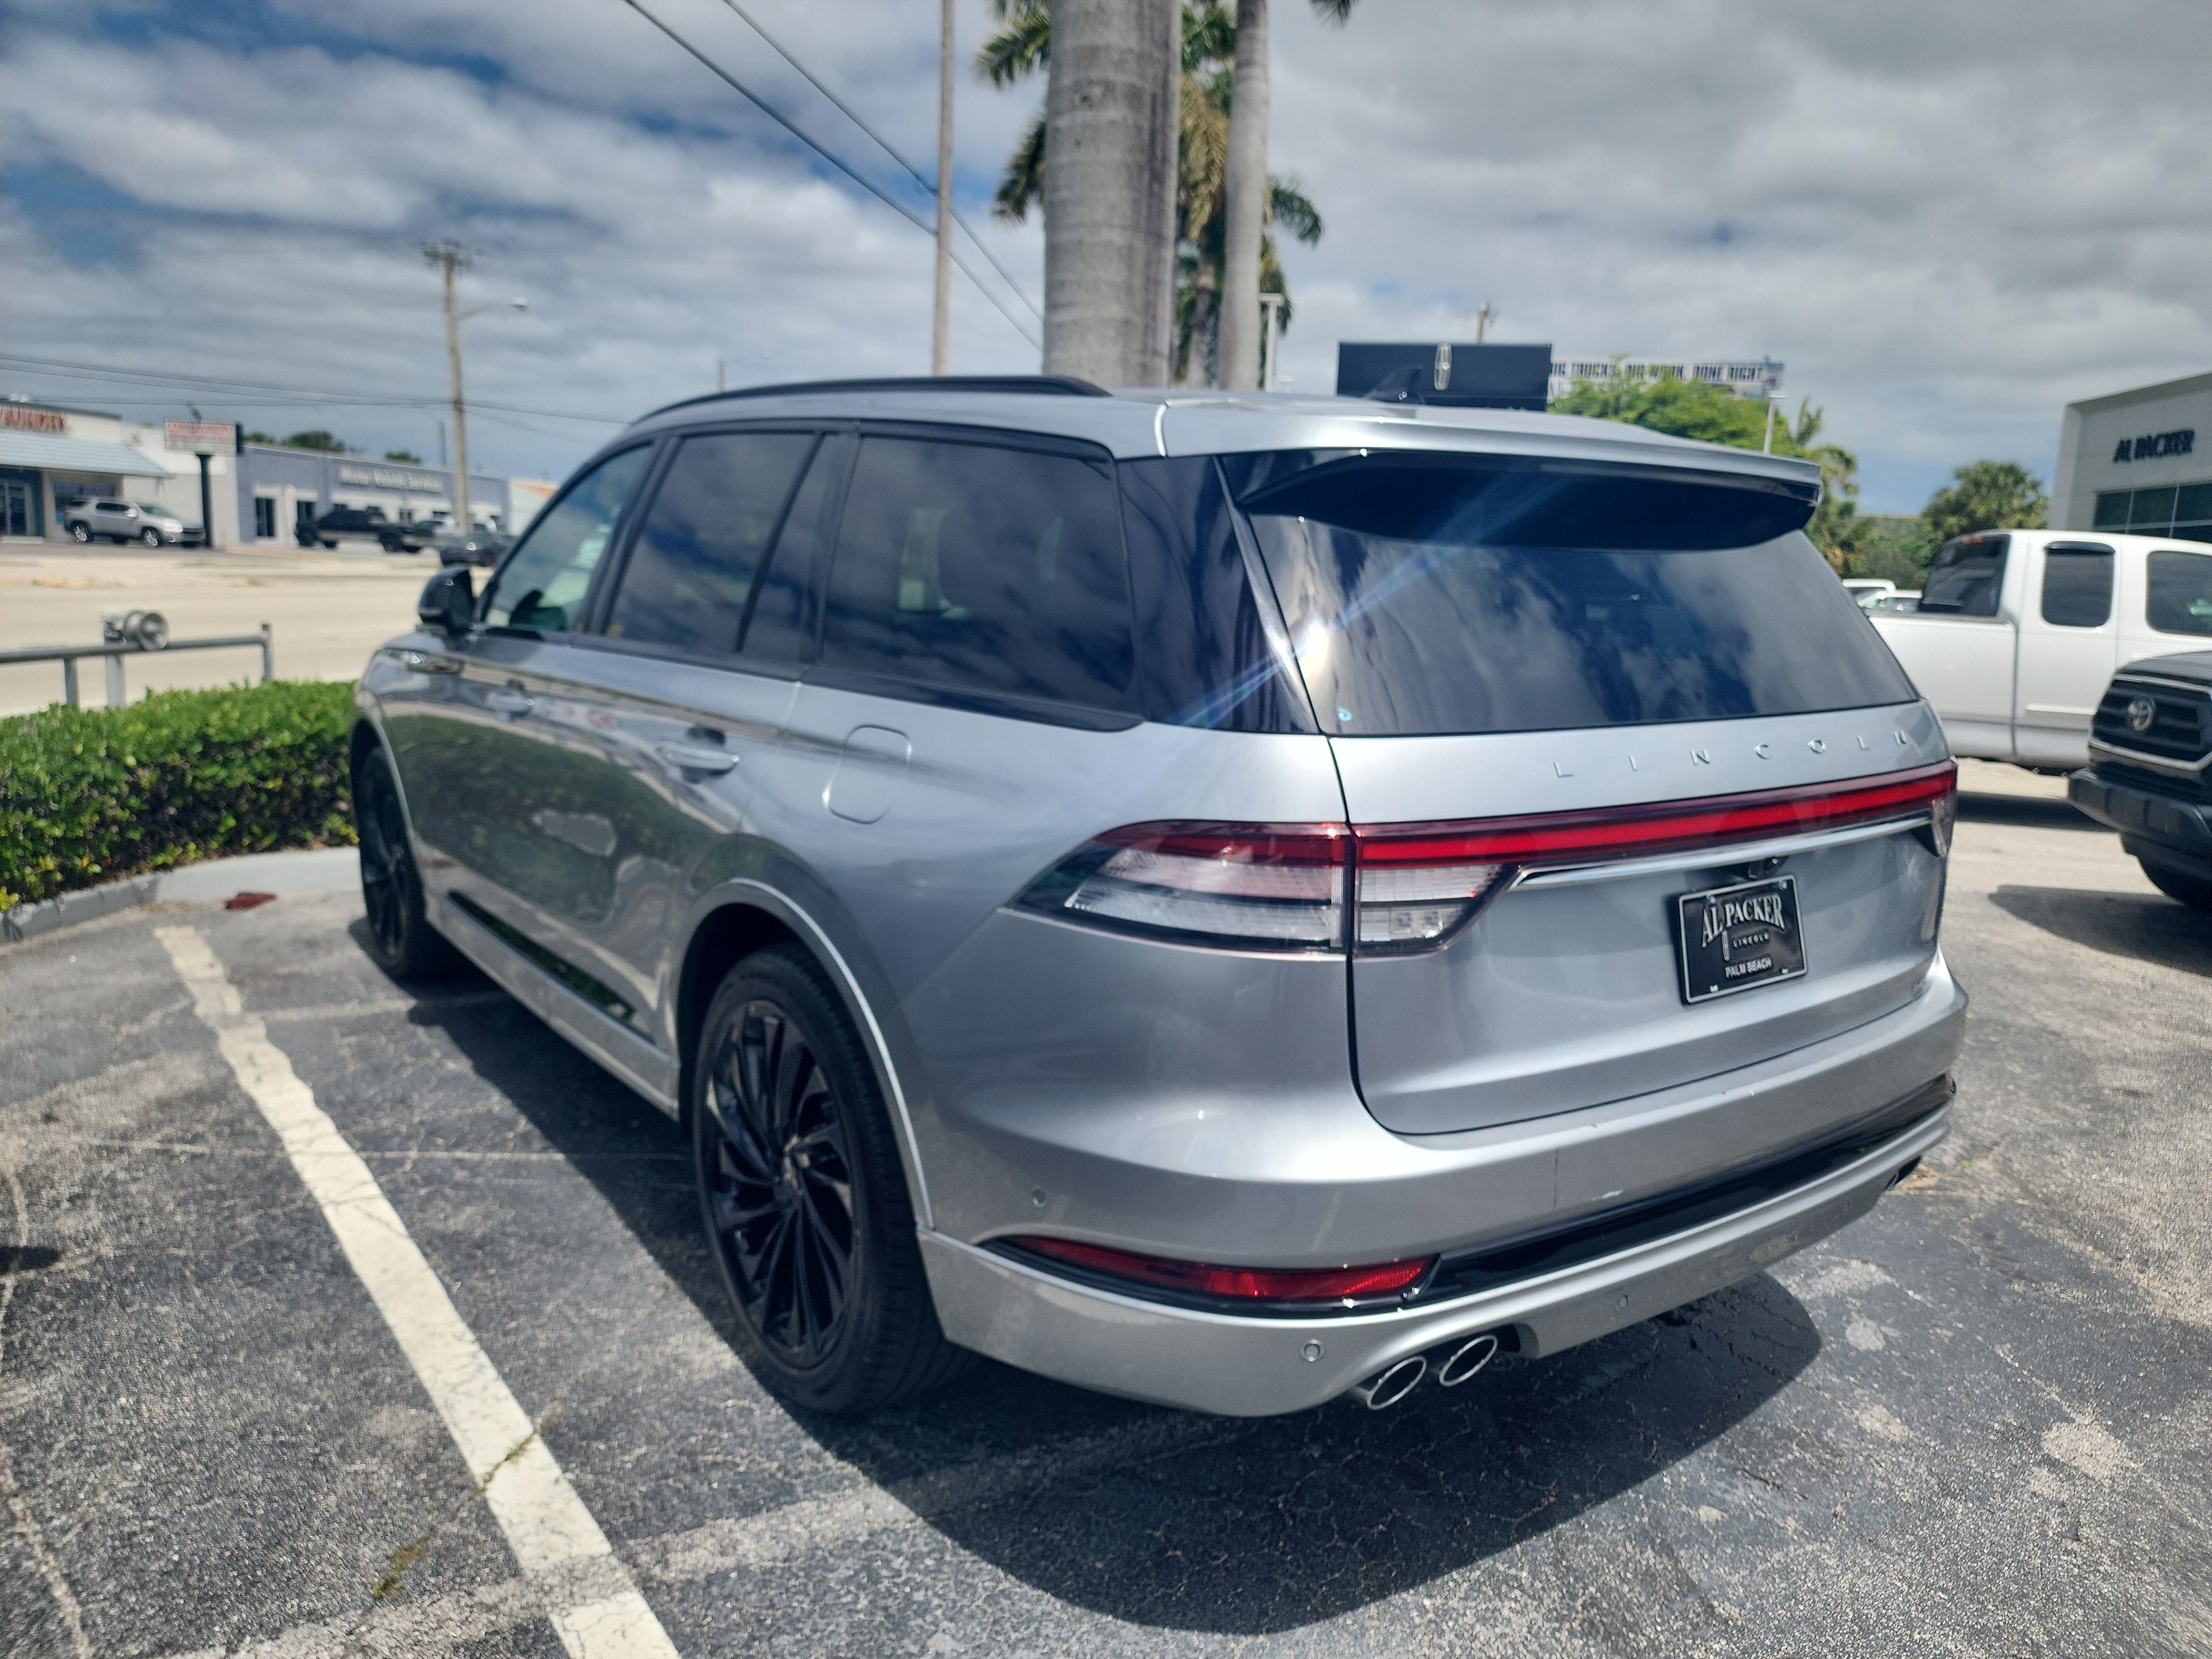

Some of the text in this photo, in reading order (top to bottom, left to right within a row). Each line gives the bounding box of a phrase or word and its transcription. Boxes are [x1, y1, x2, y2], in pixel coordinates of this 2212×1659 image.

[1550, 362, 1566, 377] IG
[1552, 728, 1907, 778] LINCOLN
[1702, 894, 1785, 948] AL PACKER
[1725, 958, 1772, 978] PALM BEACH
